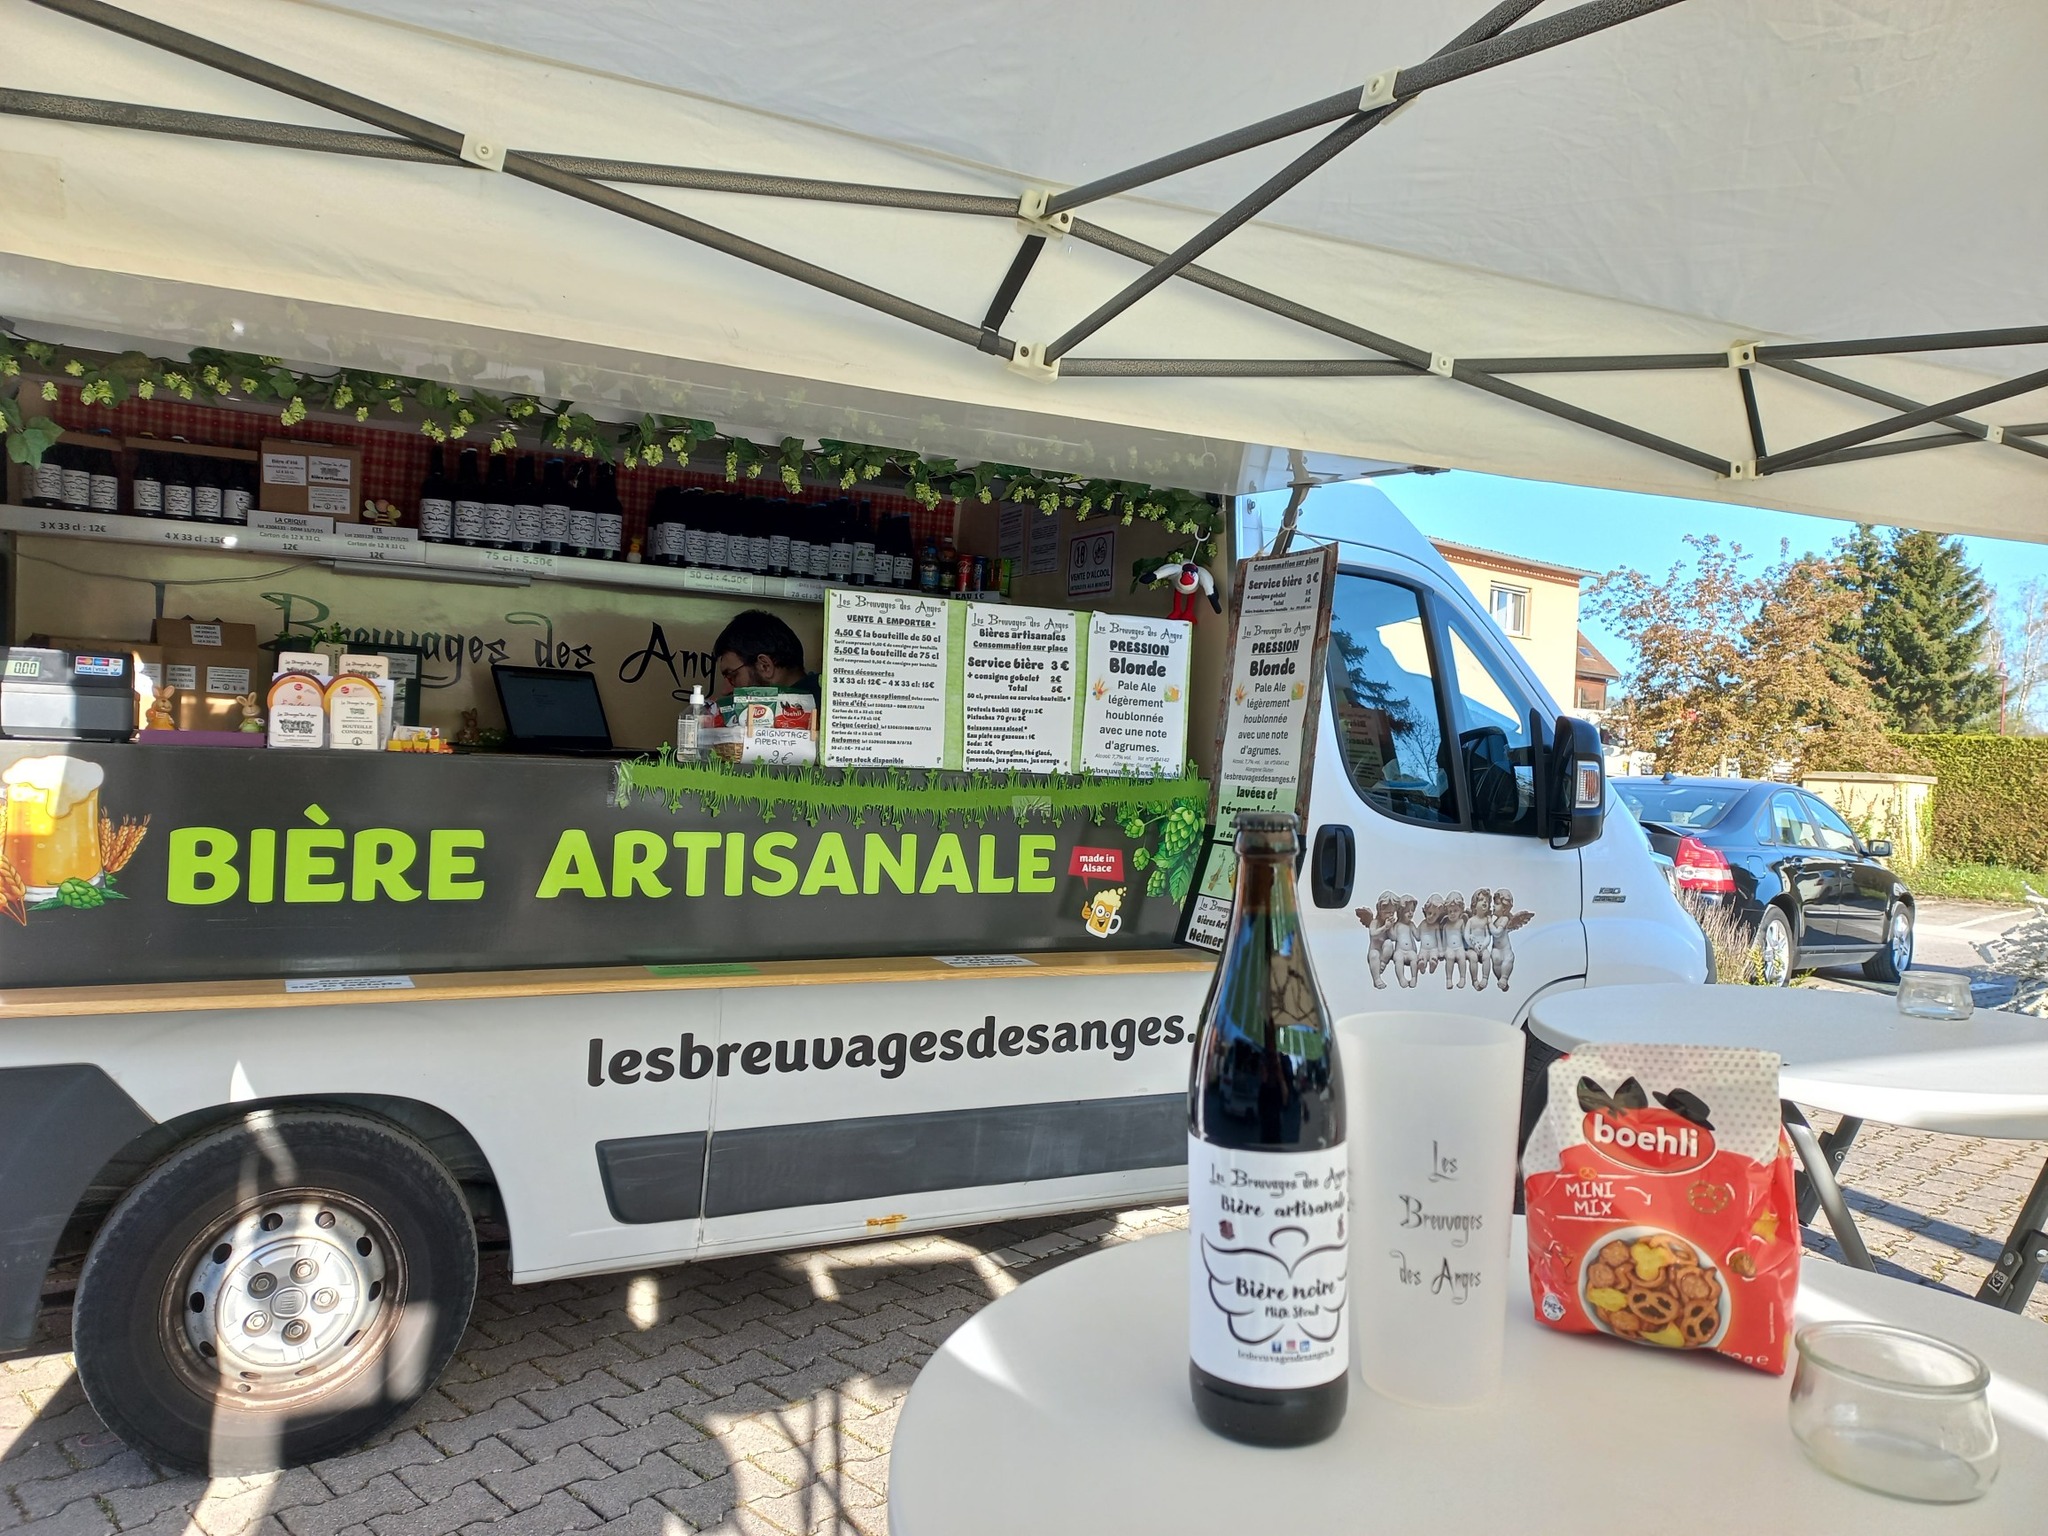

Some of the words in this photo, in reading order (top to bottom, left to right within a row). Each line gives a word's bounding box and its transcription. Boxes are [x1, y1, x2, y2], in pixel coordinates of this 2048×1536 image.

[49, 522, 56, 530] X
[58, 523, 70, 531] 33
[72, 523, 80, 532] cl
[89, 524, 106, 532] 12€
[284, 518, 306, 526] CRIQUE
[165, 532, 171, 540] 4
[172, 532, 179, 540] X
[181, 533, 192, 541] 33
[194, 534, 202, 542] cl
[282, 543, 298, 551] 12€
[370, 551, 384, 559] 12€
[486, 551, 500, 560] 75
[522, 556, 553, 566] 5.50€
[690, 571, 701, 579] 50
[722, 574, 748, 584] 4.50€
[1249, 578, 1281, 590] Service
[1282, 574, 1302, 587] bière
[1313, 572, 1319, 583] €
[837, 594, 851, 608] Les
[855, 595, 896, 614] Breuvages
[895, 598, 911, 611] des
[915, 601, 941, 617] Anges
[846, 614, 874, 623] VENTE
[886, 617, 931, 627] EMPORTER
[972, 613, 984, 626] Les
[988, 614, 1026, 631] Breuvages
[1025, 616, 1040, 627] des
[1044, 618, 1068, 633] Anges
[834, 628, 854, 637] 4,50
[863, 630, 870, 638] la
[872, 631, 908, 641] bouteille
[910, 633, 920, 641] de
[921, 634, 932, 642] 50
[934, 635, 940, 643] cl
[979, 627, 1010, 638] Bières
[1011, 630, 1066, 641] artisanales
[1094, 621, 1106, 634] Les
[1110, 622, 1144, 640] Breuvages
[1143, 626, 1157, 637] des
[1160, 628, 1182, 644] Anges
[834, 646, 860, 654] 5,50€
[870, 648, 906, 658] bouteille
[908, 650, 918, 658] de
[932, 652, 939, 660] cl
[973, 640, 1031, 650] Consommation
[1048, 645, 1068, 653] place
[1110, 640, 1169, 656] PRESSION
[1252, 640, 1300, 654] PRESSION
[506, 611, 596, 669] des
[619, 621, 719, 701] Ang
[968, 657, 1011, 668] Service
[1014, 658, 1044, 670] bière
[1051, 661, 1058, 670] 3
[1060, 661, 1070, 671] €
[1110, 657, 1166, 677] Blonde
[1250, 657, 1295, 676] Blonde
[974, 672, 1008, 683] consigne
[1010, 674, 1040, 683] gobelet
[1118, 680, 1138, 691] Pale
[1141, 683, 1156, 692] Ale
[1255, 682, 1272, 692] Pale
[1273, 682, 1286, 692] Ale
[1108, 695, 1164, 708] légèrement
[1247, 698, 1290, 710] légèrement
[1106, 710, 1164, 723] houblonnée
[1243, 713, 1288, 724] houblonnée
[755, 730, 809, 739] GRIGNOTAGE
[1099, 726, 1123, 735] avec
[1125, 728, 1143, 736] une
[1145, 729, 1167, 738] note
[1238, 731, 1255, 739] avec
[1257, 731, 1270, 739] une
[1271, 731, 1288, 739] note
[755, 738, 797, 746] APERITIF
[1105, 740, 1159, 752] d'agrumes.
[768, 750, 794, 765] 2€
[1240, 745, 1281, 757] d'agrumes.
[872, 757, 904, 765] disponible
[1224, 772, 1296, 784] lesbreuvagesdesanges.fr
[1236, 786, 1266, 799] lavées
[1267, 788, 1278, 800] et
[167, 803, 485, 906] BIÈRE
[535, 828, 1057, 900] ARTISANALE
[1080, 854, 1105, 862] made
[1106, 854, 1115, 863] in
[1082, 864, 1112, 872] Alsace
[1197, 915, 1215, 927] Bières
[586, 1014, 1196, 1088] lesbreuvagesdesanges.
[1593, 1114, 1698, 1158] boehli
[1428, 1140, 1459, 1182] Les
[1209, 1163, 1226, 1187] Les
[1231, 1168, 1297, 1198] Breuvages
[1294, 1170, 1319, 1189] des
[1565, 1181, 1616, 1198] MINI
[1221, 1194, 1264, 1217] Bière
[1274, 1191, 1345, 1218] artisanal
[1574, 1201, 1612, 1216] MIX
[1398, 1194, 1483, 1248] Breuvages
[1389, 1250, 1422, 1286] des
[1431, 1257, 1481, 1305] Anges
[1235, 1277, 1288, 1300] Bière
[1293, 1278, 1336, 1300] noire
[1265, 1306, 1290, 1318] Milk
[1292, 1305, 1320, 1319] Stout
